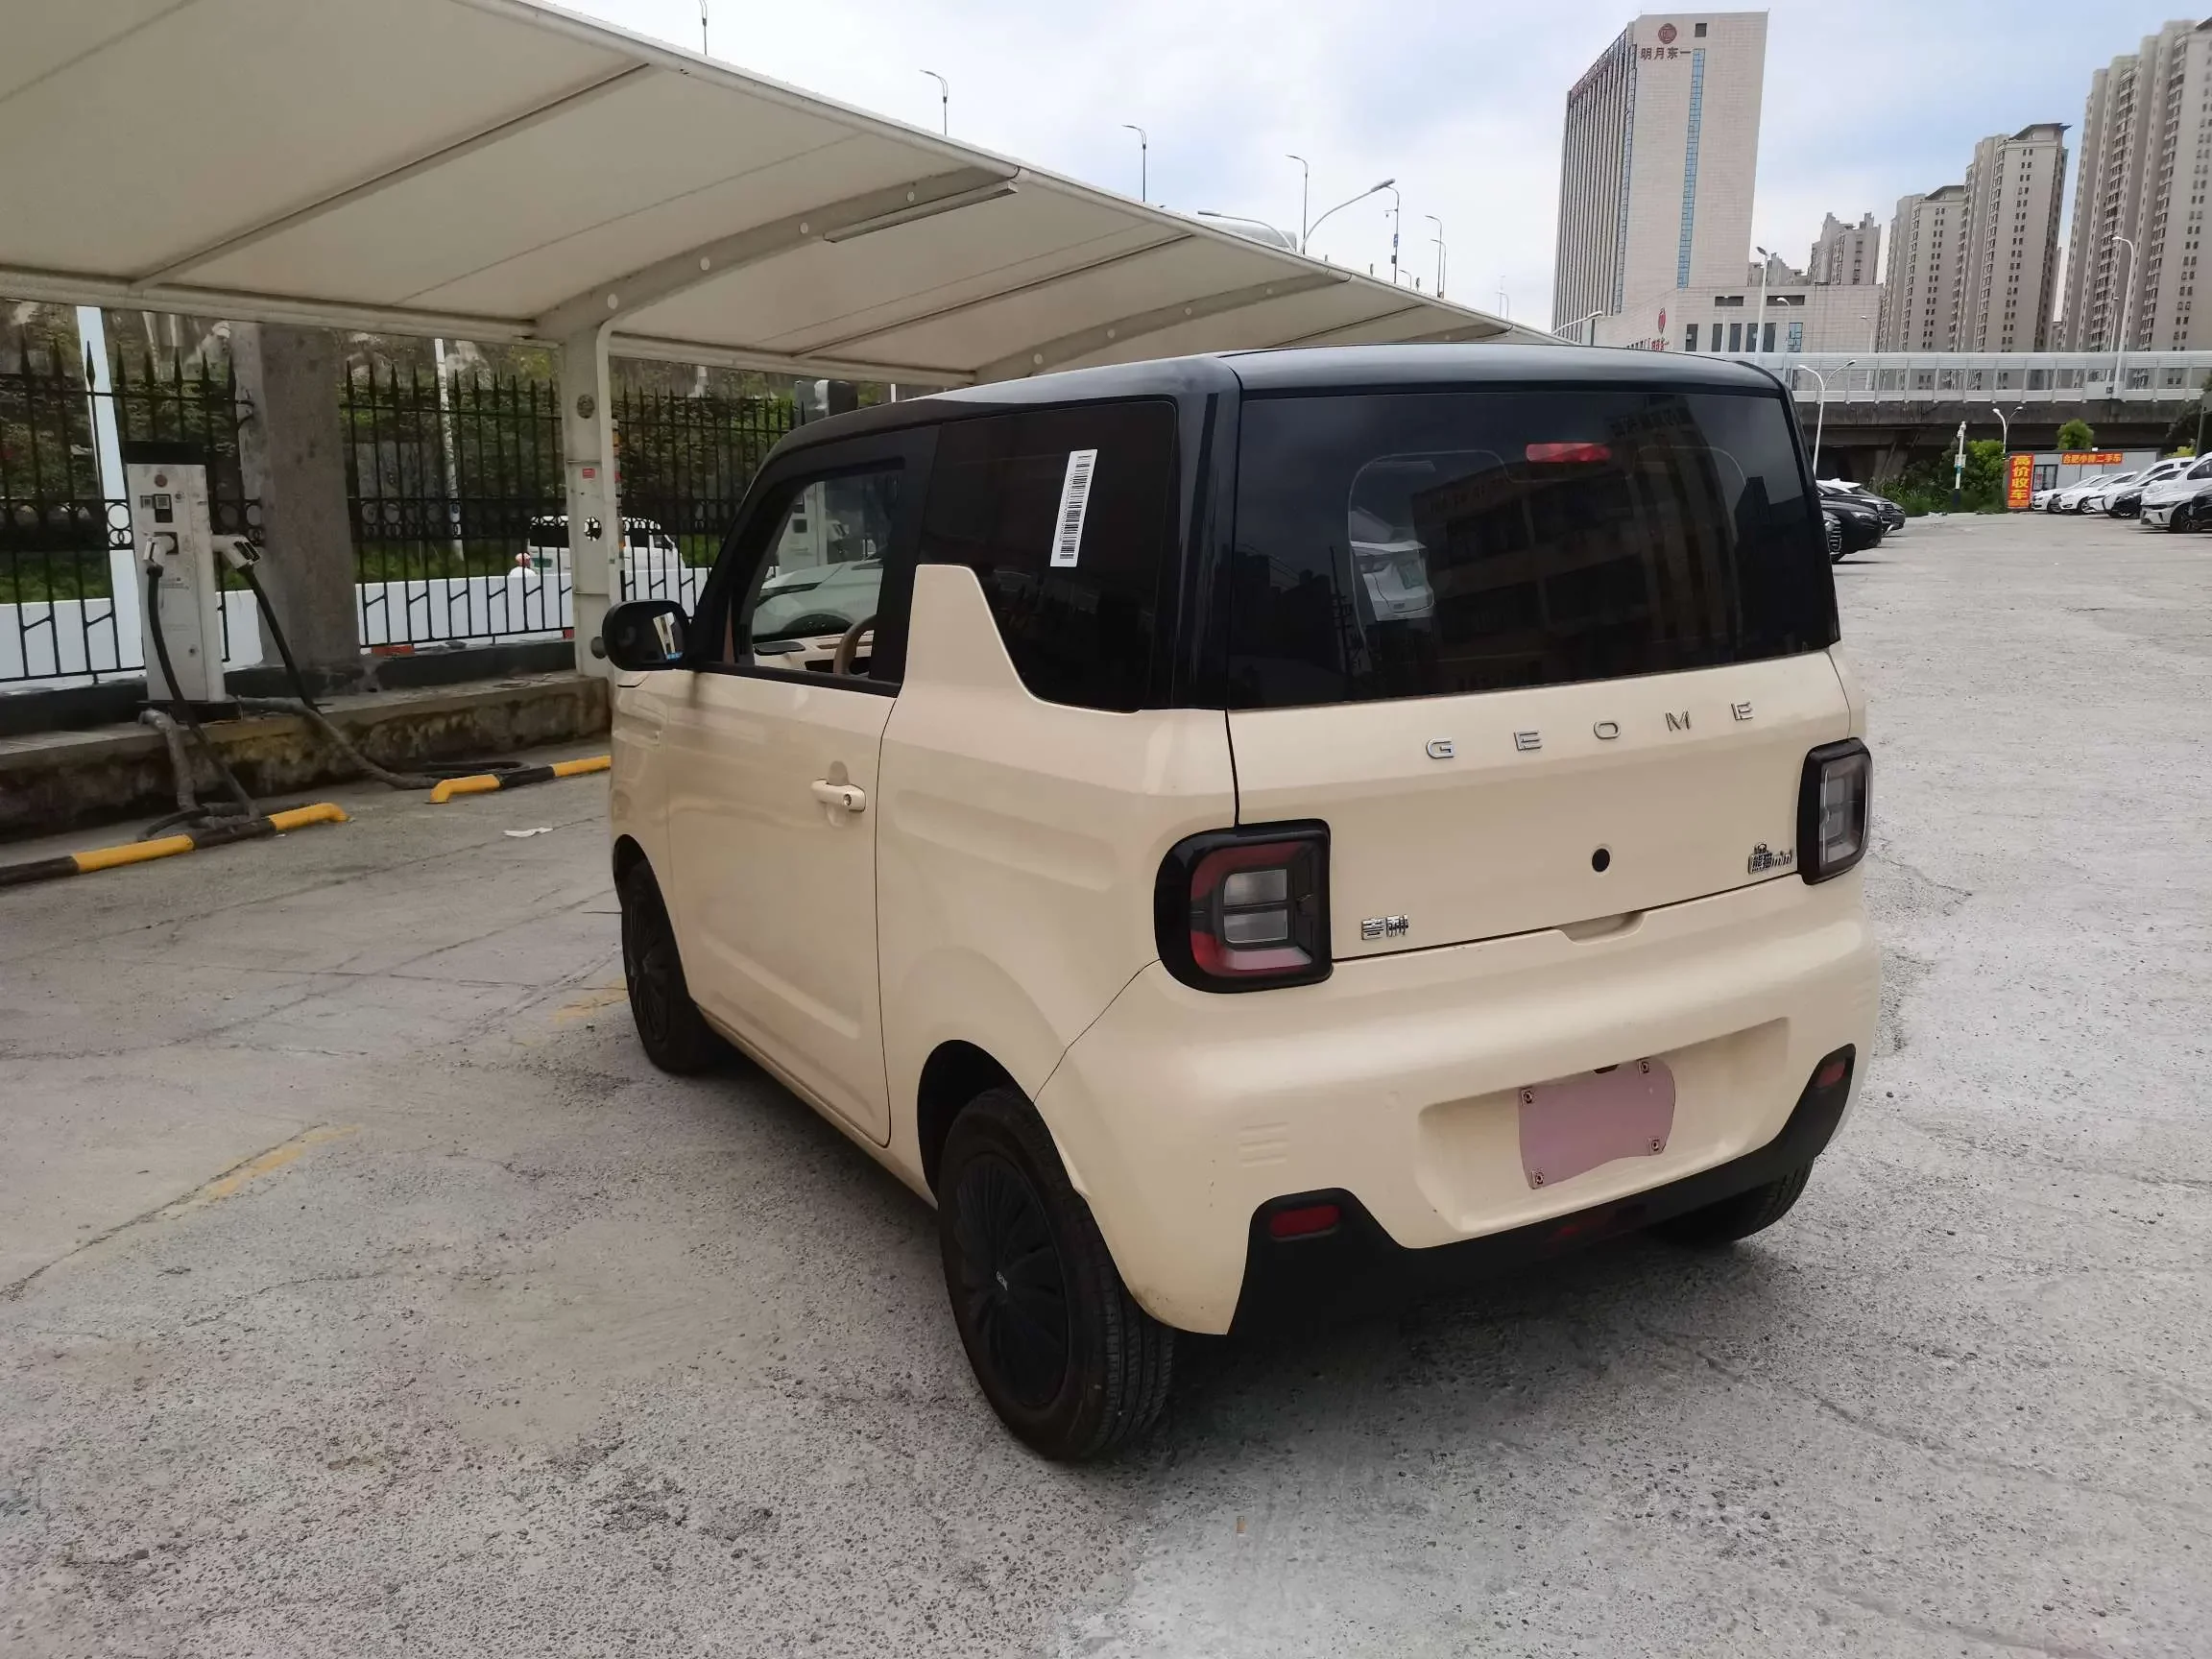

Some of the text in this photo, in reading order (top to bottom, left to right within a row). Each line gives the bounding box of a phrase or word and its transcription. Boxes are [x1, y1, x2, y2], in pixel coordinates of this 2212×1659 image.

[2010, 456, 2032, 500] 高价收车
[1426, 702, 1753, 759] GEOME
